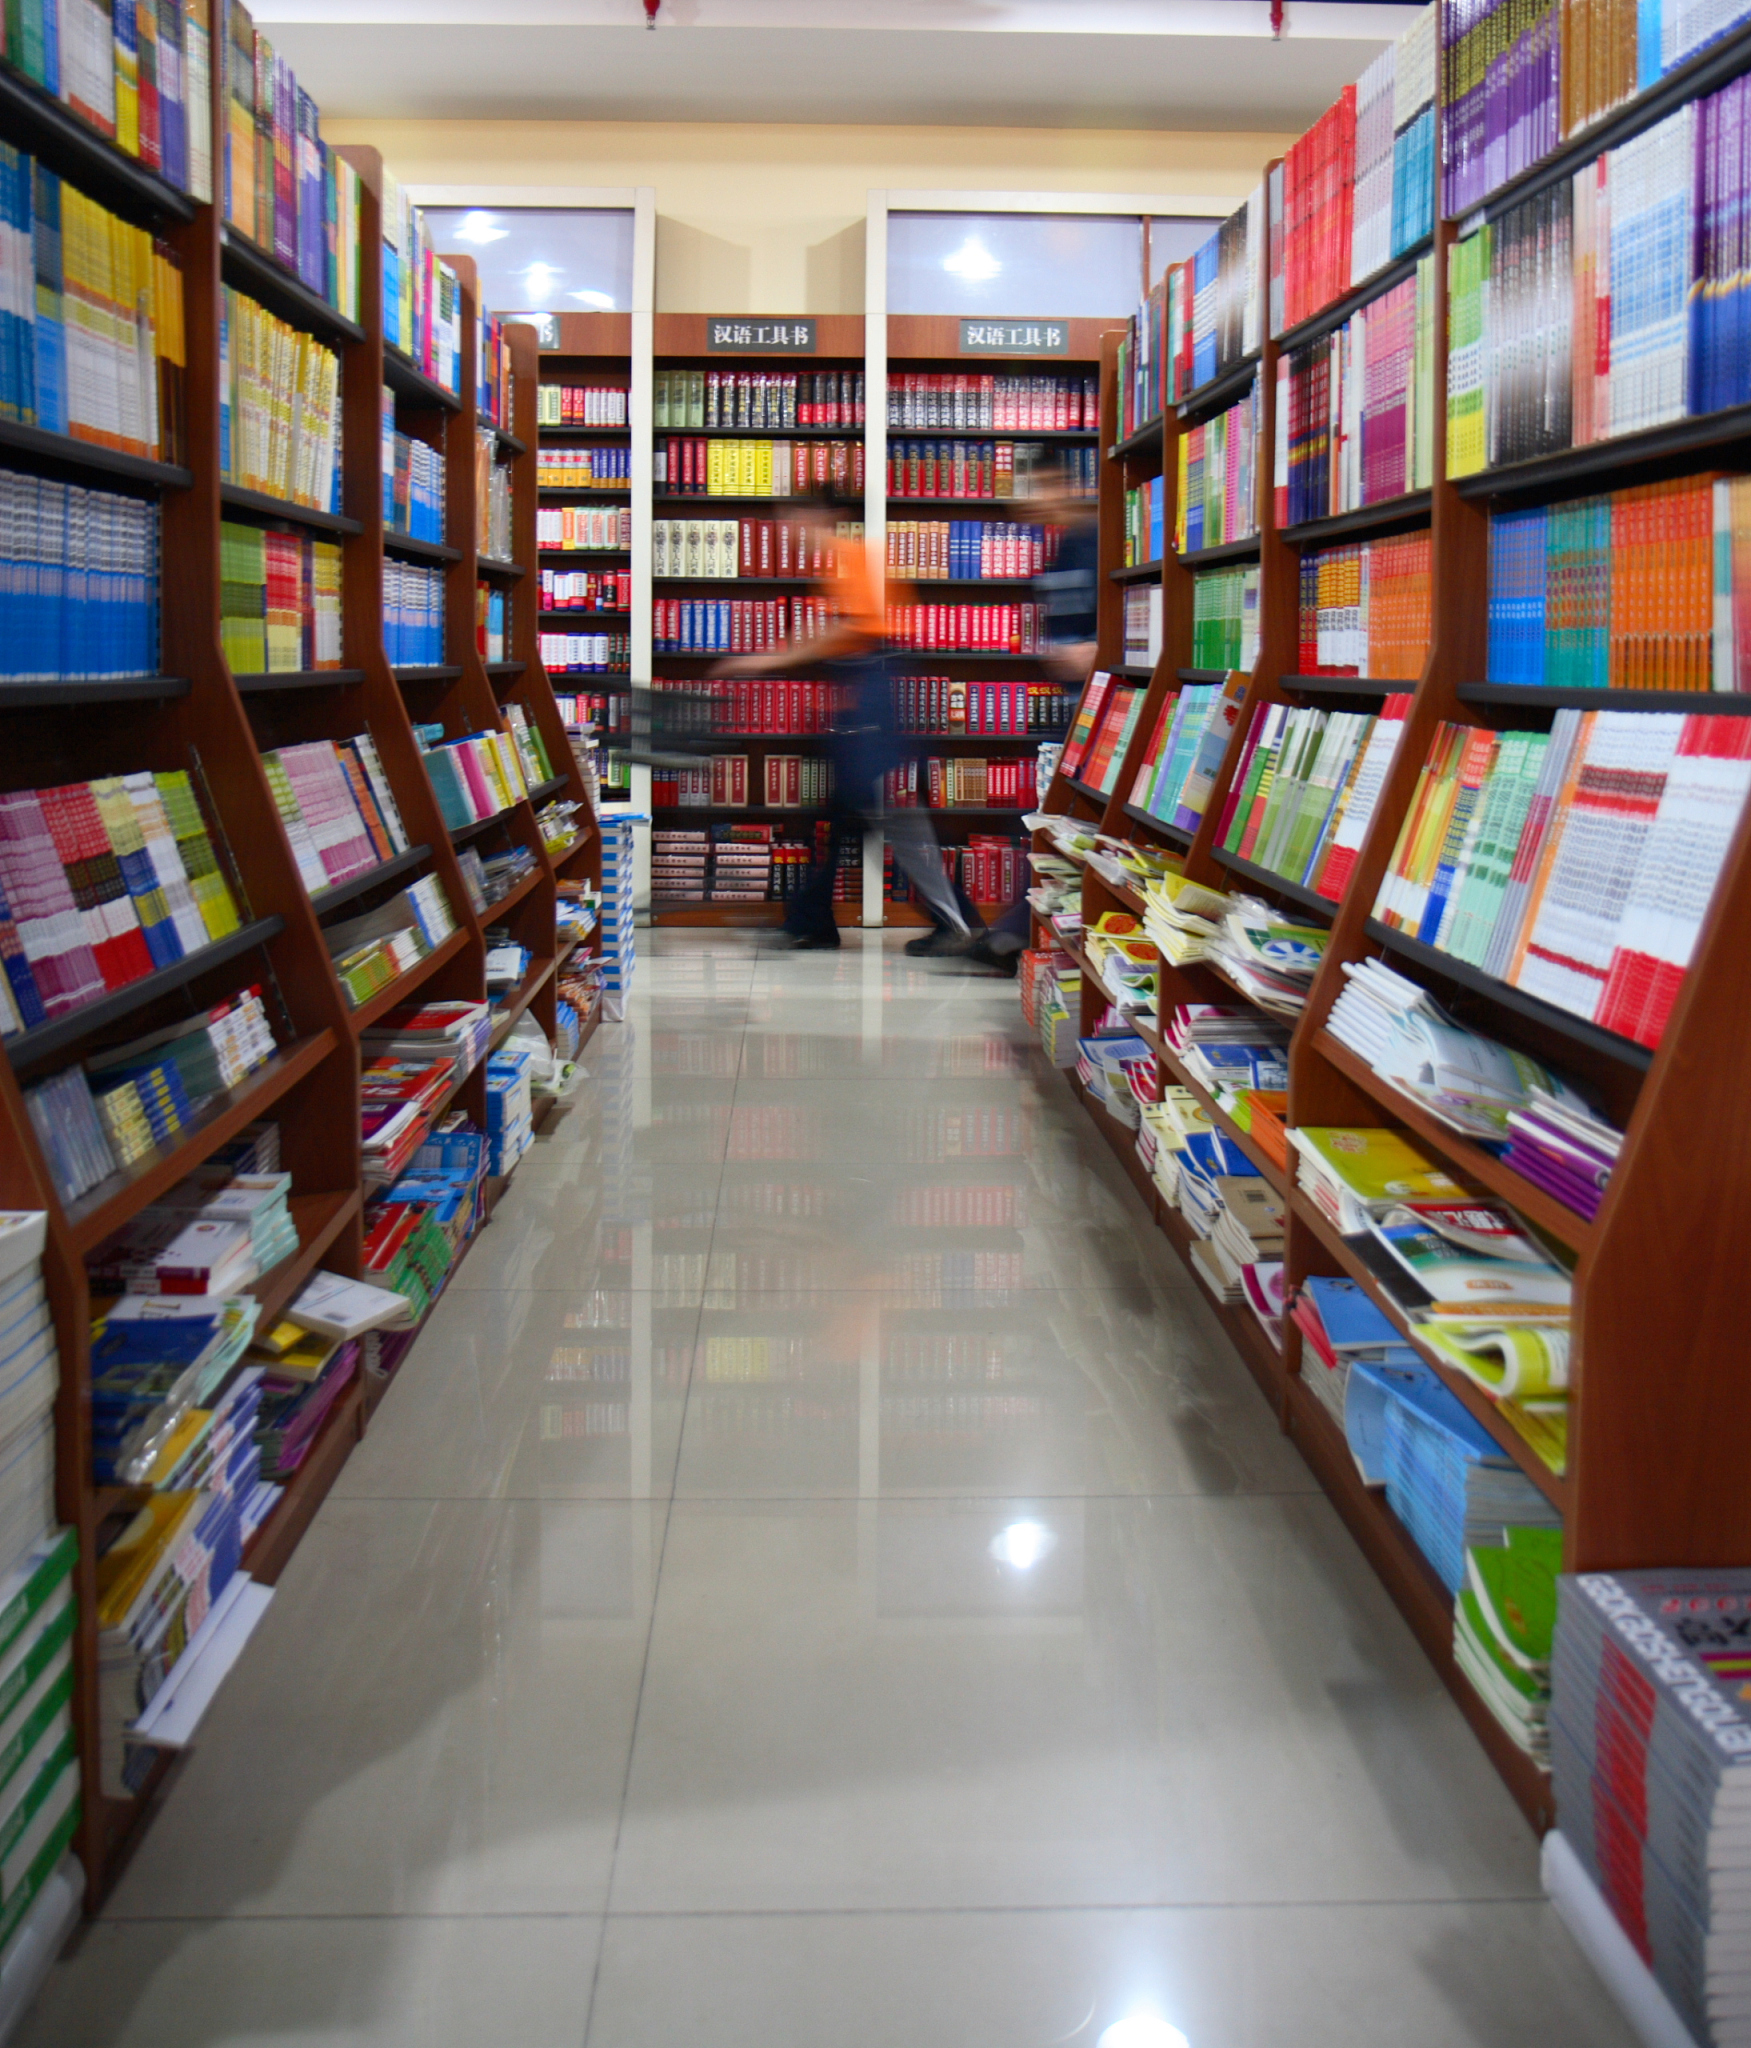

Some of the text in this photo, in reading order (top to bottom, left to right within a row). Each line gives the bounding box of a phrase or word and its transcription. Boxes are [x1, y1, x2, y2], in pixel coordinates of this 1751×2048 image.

[714, 325, 809, 345] 汉语工具书
[967, 326, 1061, 347] 汉语工具书
